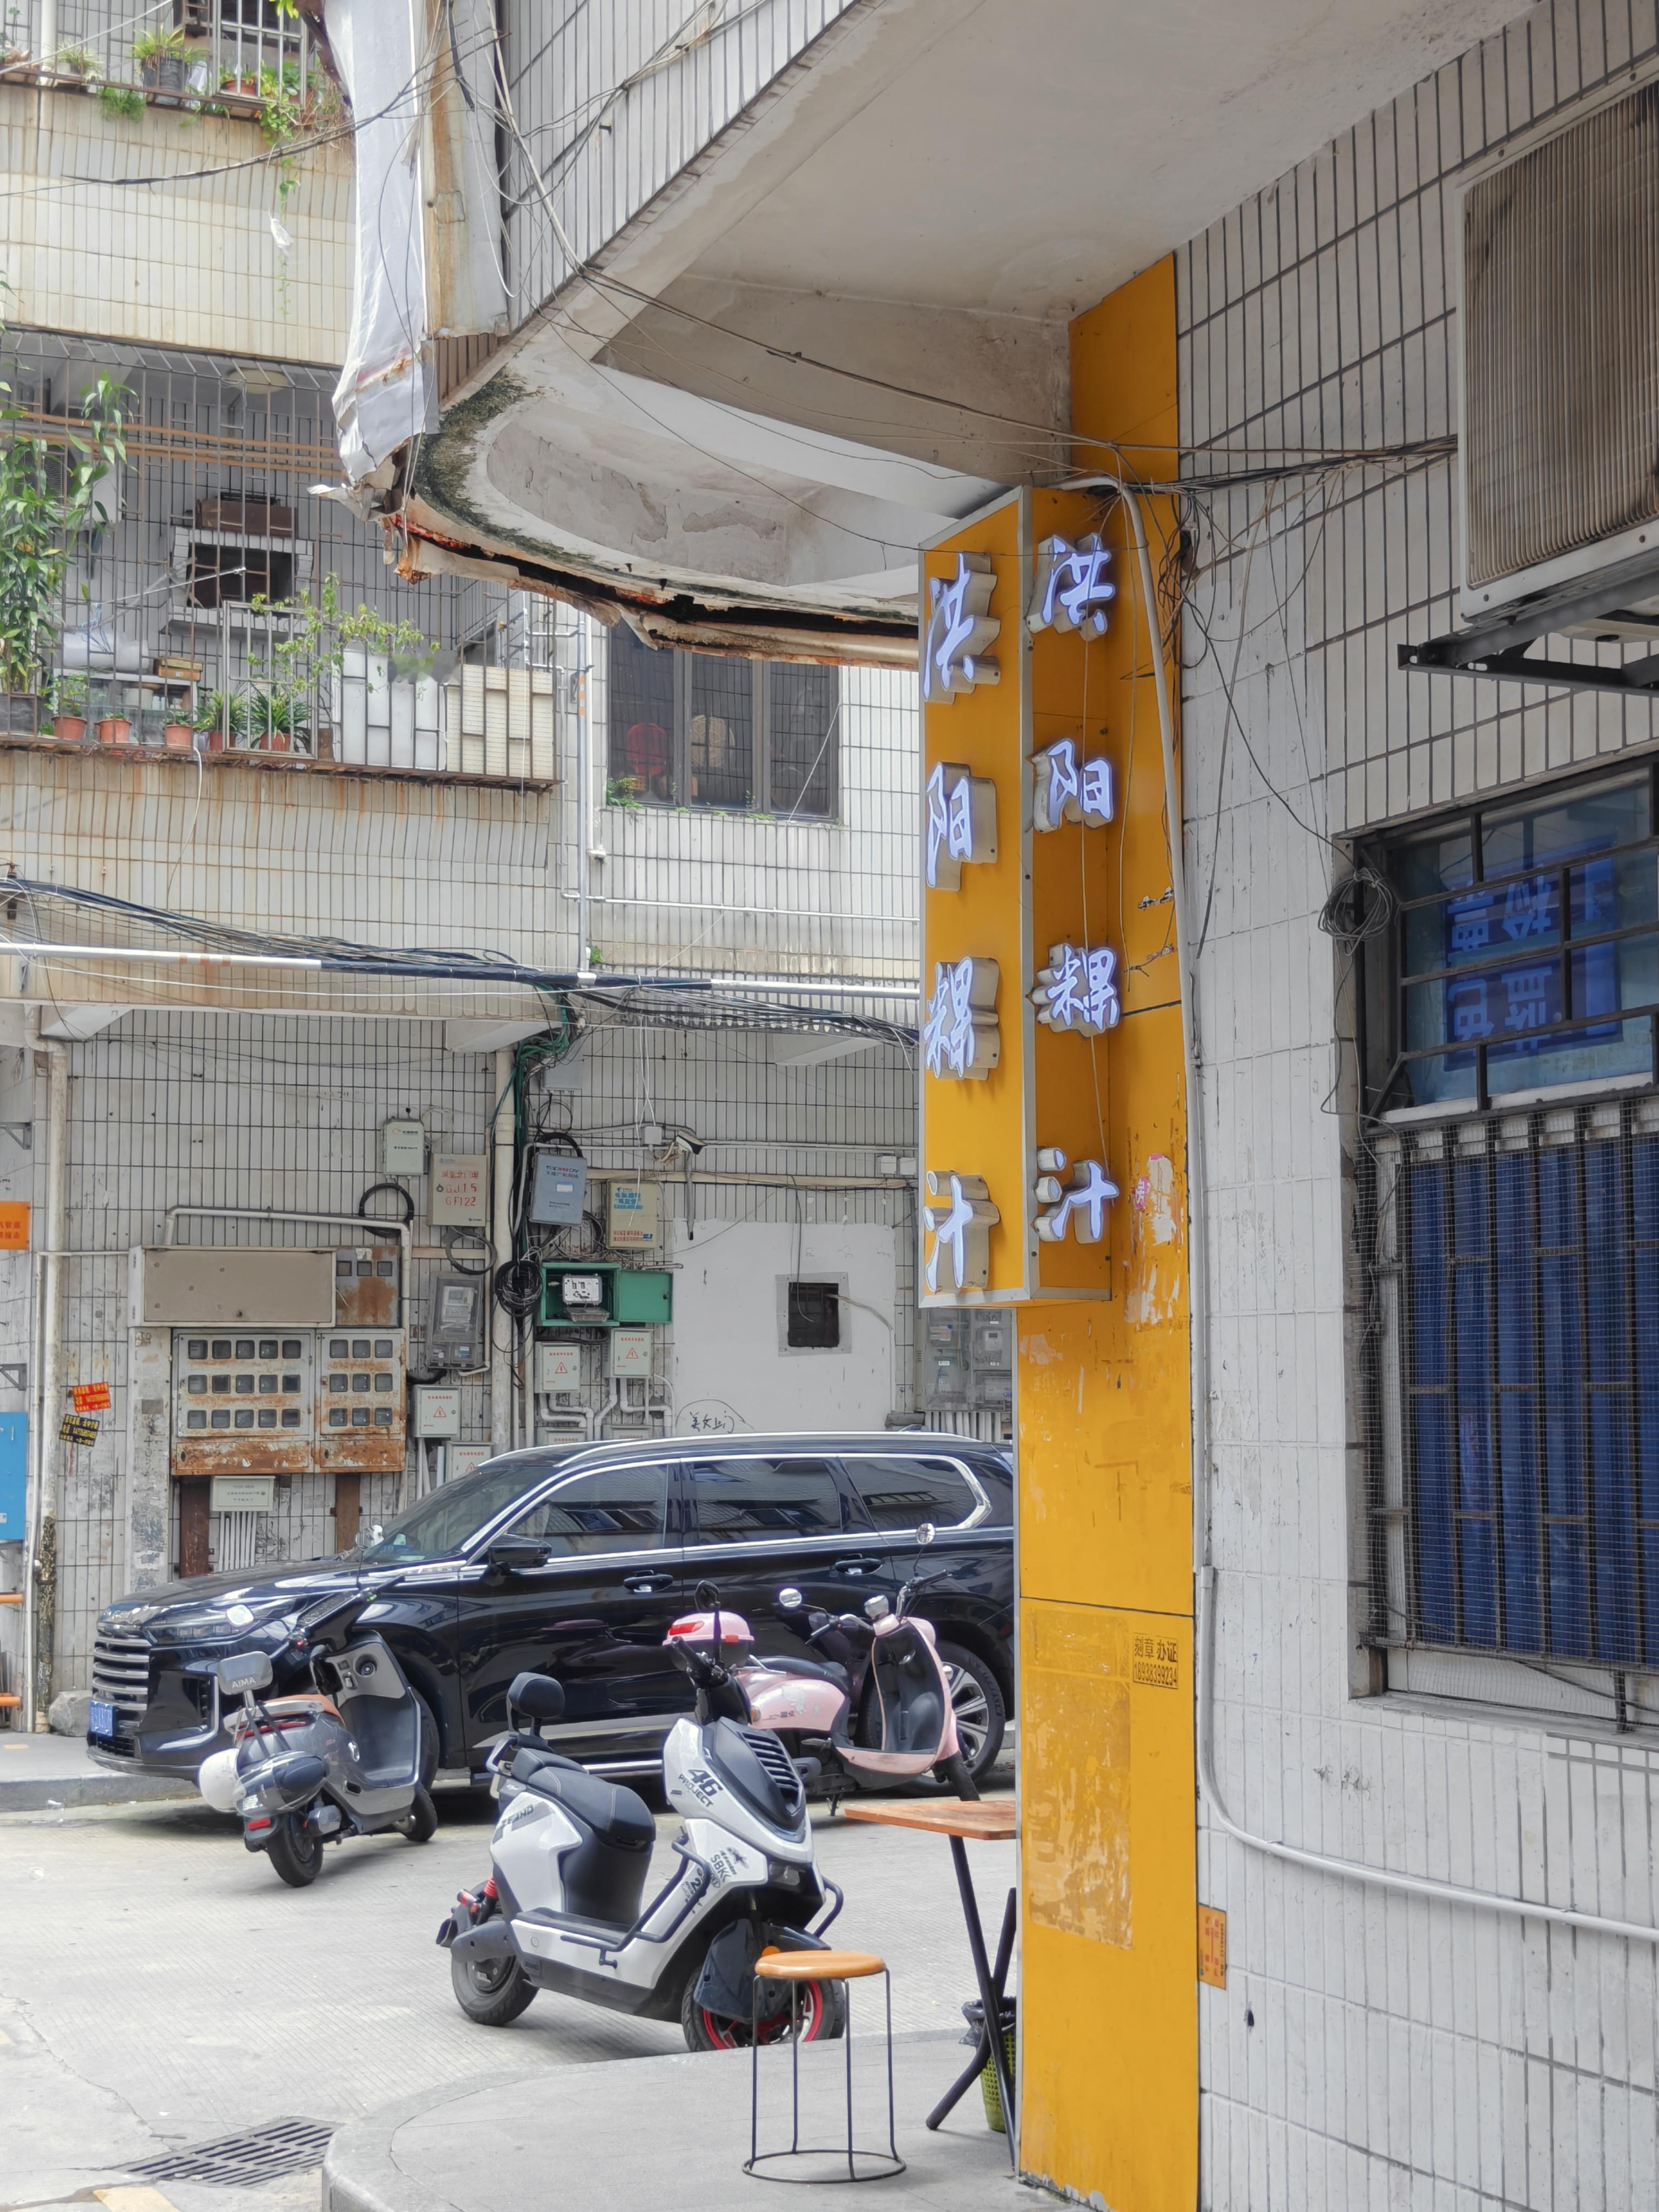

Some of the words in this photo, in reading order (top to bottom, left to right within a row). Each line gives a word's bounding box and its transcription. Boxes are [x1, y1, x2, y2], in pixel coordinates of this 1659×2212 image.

[1135, 1636, 1154, 1659] 刻章
[1157, 1639, 1177, 1663] 办证
[232, 1677, 257, 1690] AIMA
[678, 1773, 714, 1807] PROJECT
[688, 1769, 723, 1796] 46
